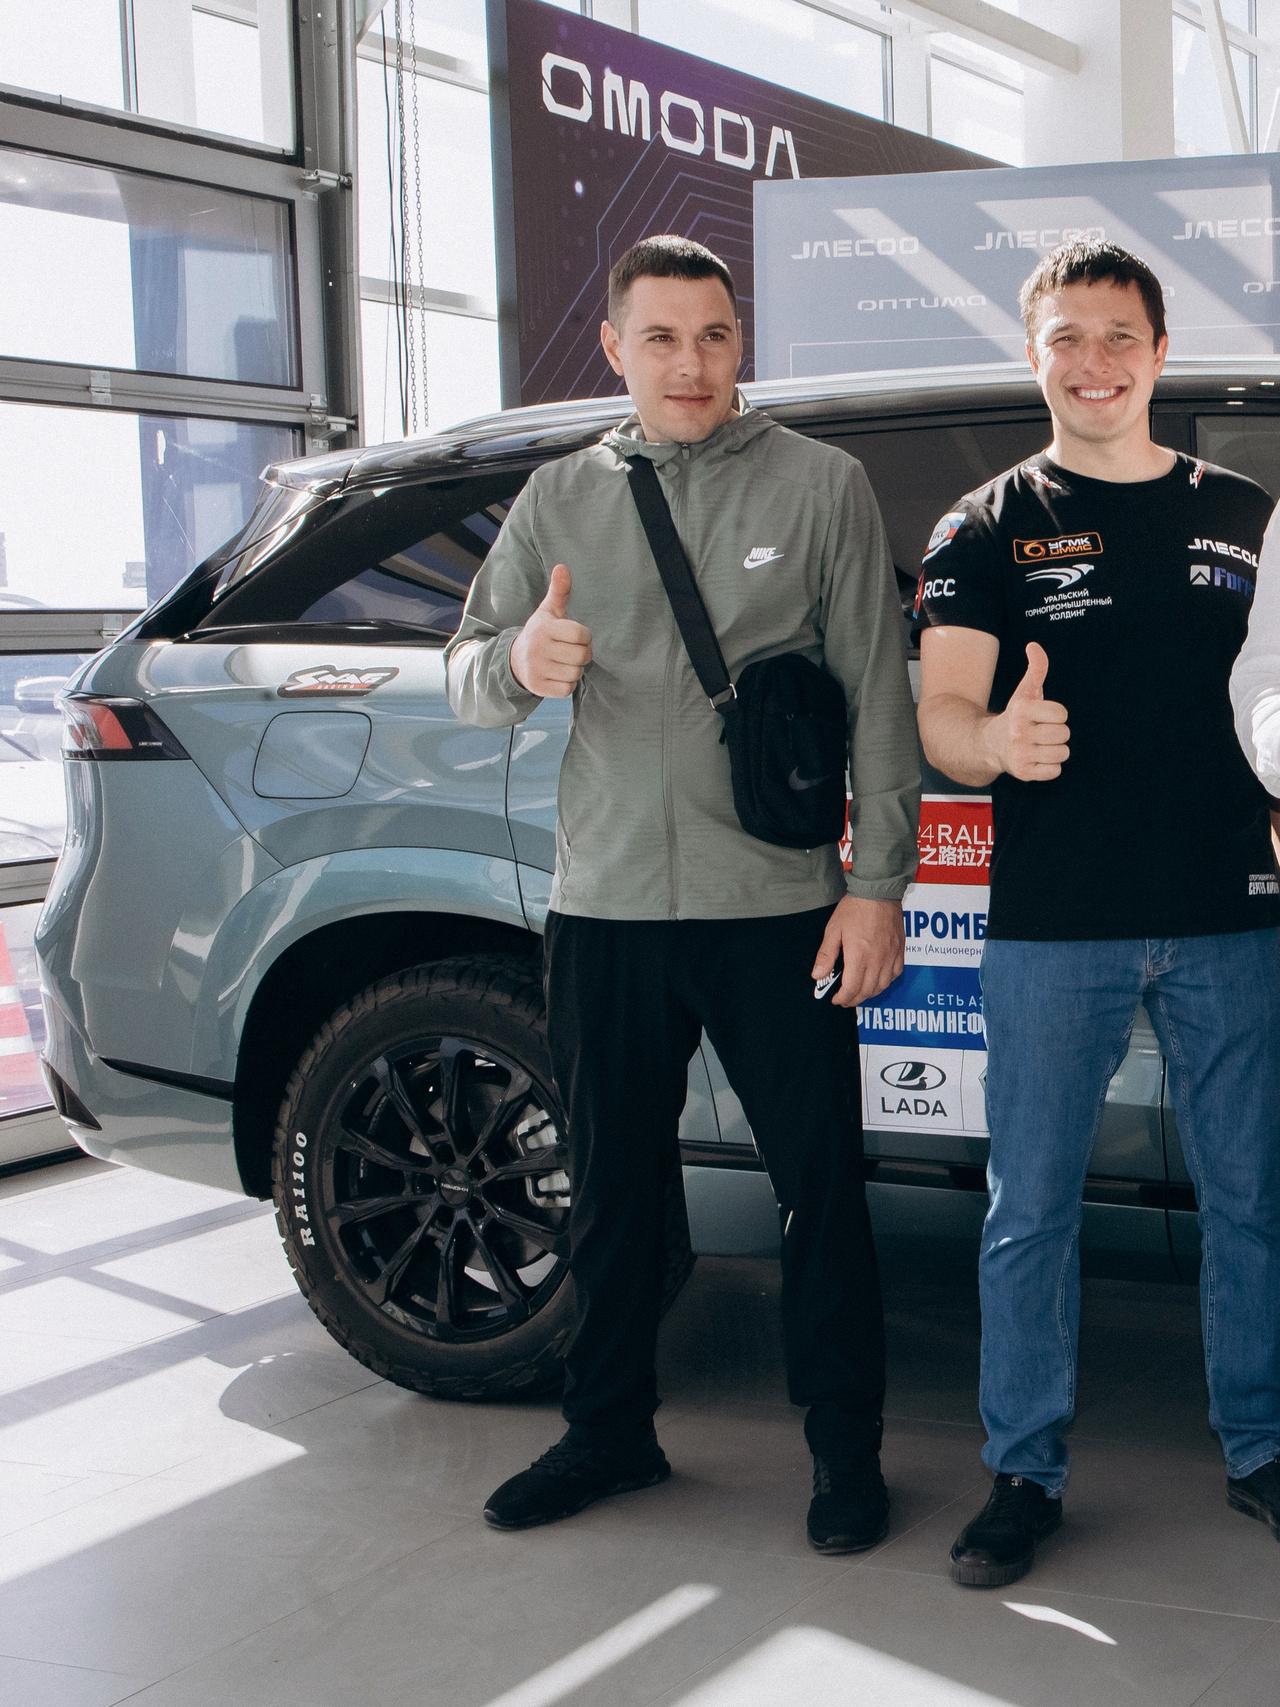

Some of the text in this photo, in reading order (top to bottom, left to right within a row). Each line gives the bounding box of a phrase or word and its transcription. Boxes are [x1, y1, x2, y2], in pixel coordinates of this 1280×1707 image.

[541, 52, 799, 180] OMODA
[790, 235, 919, 260] JAECOO
[1048, 536, 1091, 550] УГМК
[1050, 543, 1093, 556] UMMC
[749, 547, 777, 559] NIKE
[922, 578, 956, 601] RCC
[1044, 588, 1090, 604] УРАЛЬСКИЙ
[1025, 596, 1113, 618] ГОРНОПРОМЫШЛЕННЫЙ
[1049, 608, 1087, 622] ХОЛДИНГ
[927, 993, 964, 1006] СЕТЬ
[881, 1096, 948, 1117] LADA
[293, 1132, 315, 1247] RA1100
